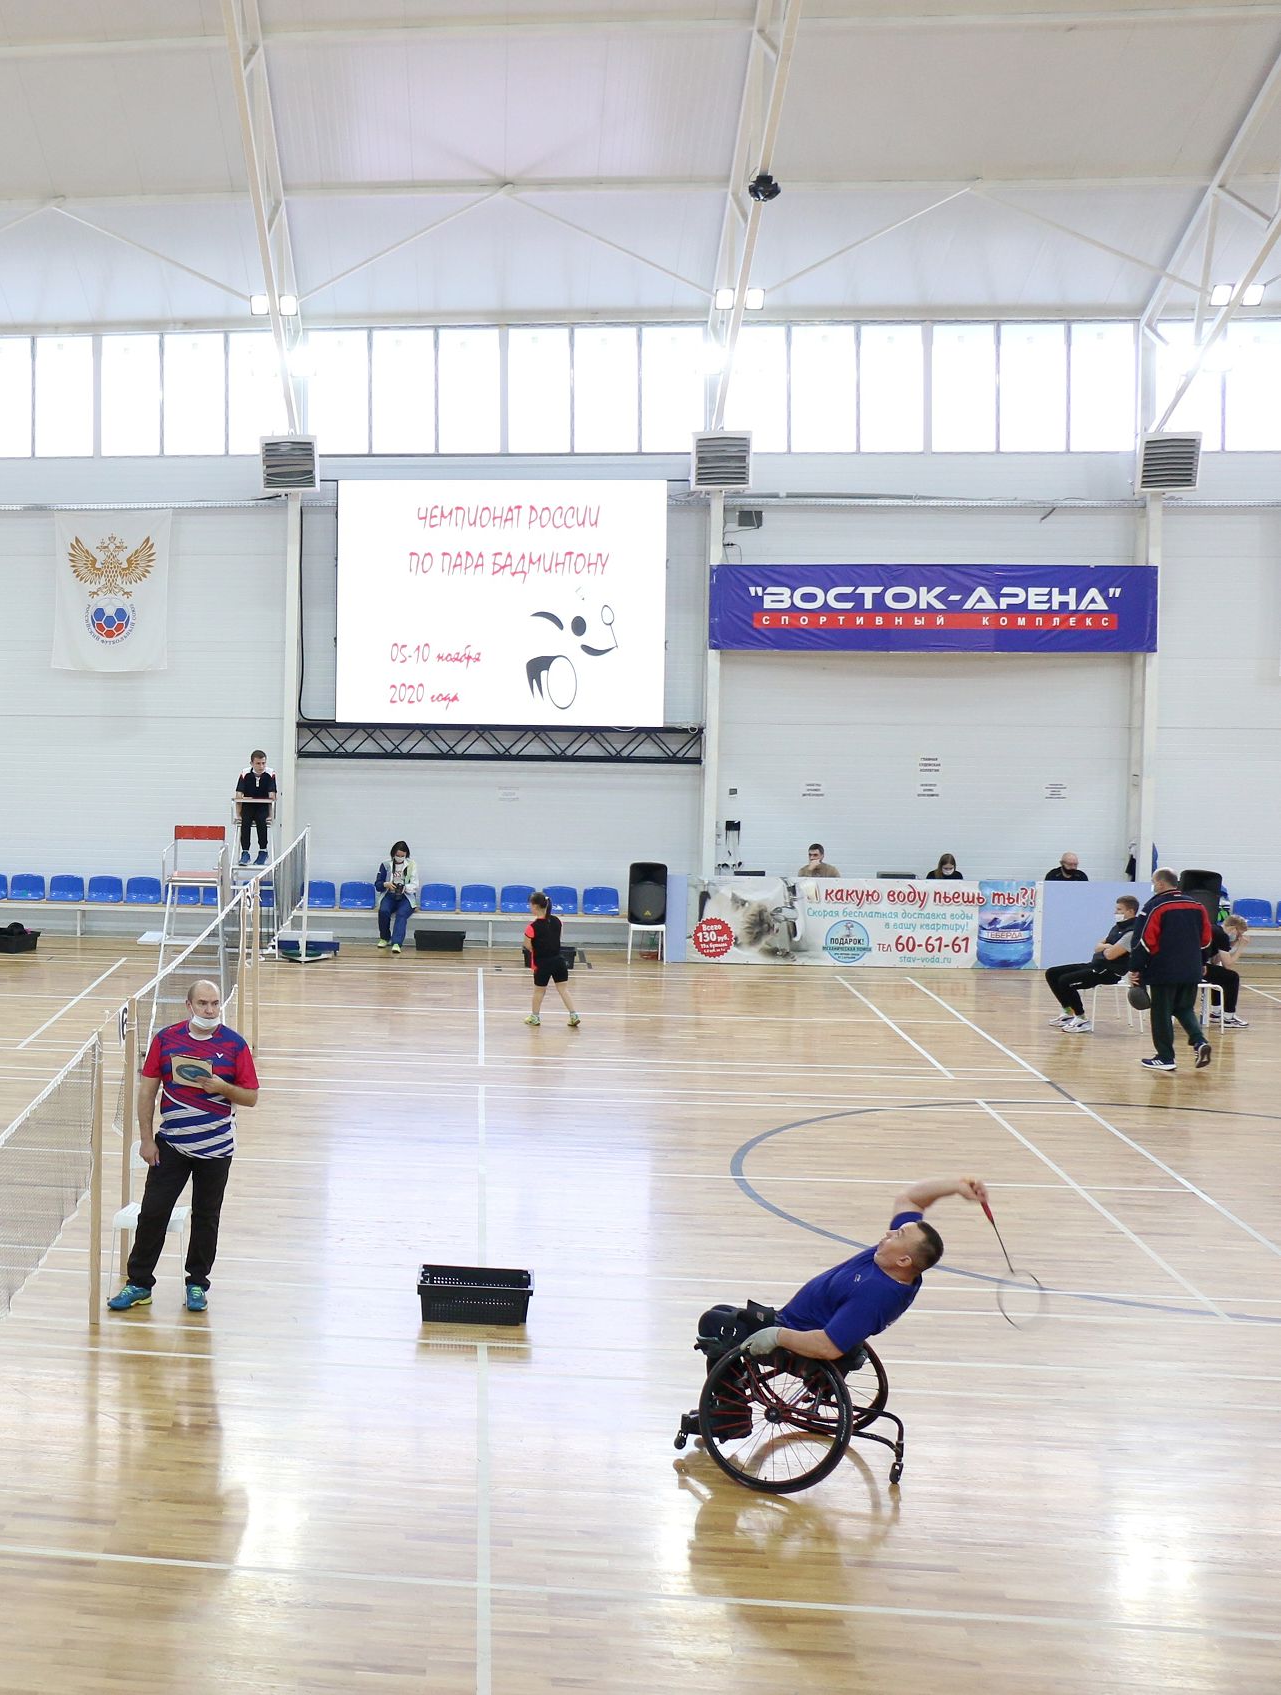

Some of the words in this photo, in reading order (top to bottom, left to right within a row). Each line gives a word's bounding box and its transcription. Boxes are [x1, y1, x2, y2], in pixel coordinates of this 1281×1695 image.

[417, 504, 523, 530] ЧЕМПИОНАТ
[528, 504, 601, 530] РОССИИ
[408, 551, 434, 576] ПО
[441, 551, 485, 576] ПАРА
[491, 551, 610, 584] БАДМИНТОНУ
[748, 586, 1122, 611] "ВОСТОК-АРЕНА"
[762, 614, 946, 626] СПОРТИВНЫЙ
[982, 616, 1110, 627] КОМПЛЕКС
[390, 643, 431, 664] 05-10
[435, 645, 482, 670] ноября
[389, 683, 425, 705] 2020
[430, 691, 460, 711] года
[824, 887, 880, 908] какую
[886, 884, 928, 909] воду
[933, 889, 985, 905] пьешь
[992, 887, 1036, 906] ты?!
[806, 908, 840, 921] Скорая
[842, 908, 899, 920] бесплатная
[901, 909, 948, 920] доставка
[950, 910, 974, 921] воды
[697, 930, 717, 943] 130
[893, 923, 917, 931] вашу
[919, 922, 969, 932] квартиру!
[830, 937, 865, 946] ПОДАРОК!
[895, 935, 970, 954] 60-61-61
[899, 955, 952, 964] stav-voda.ru
